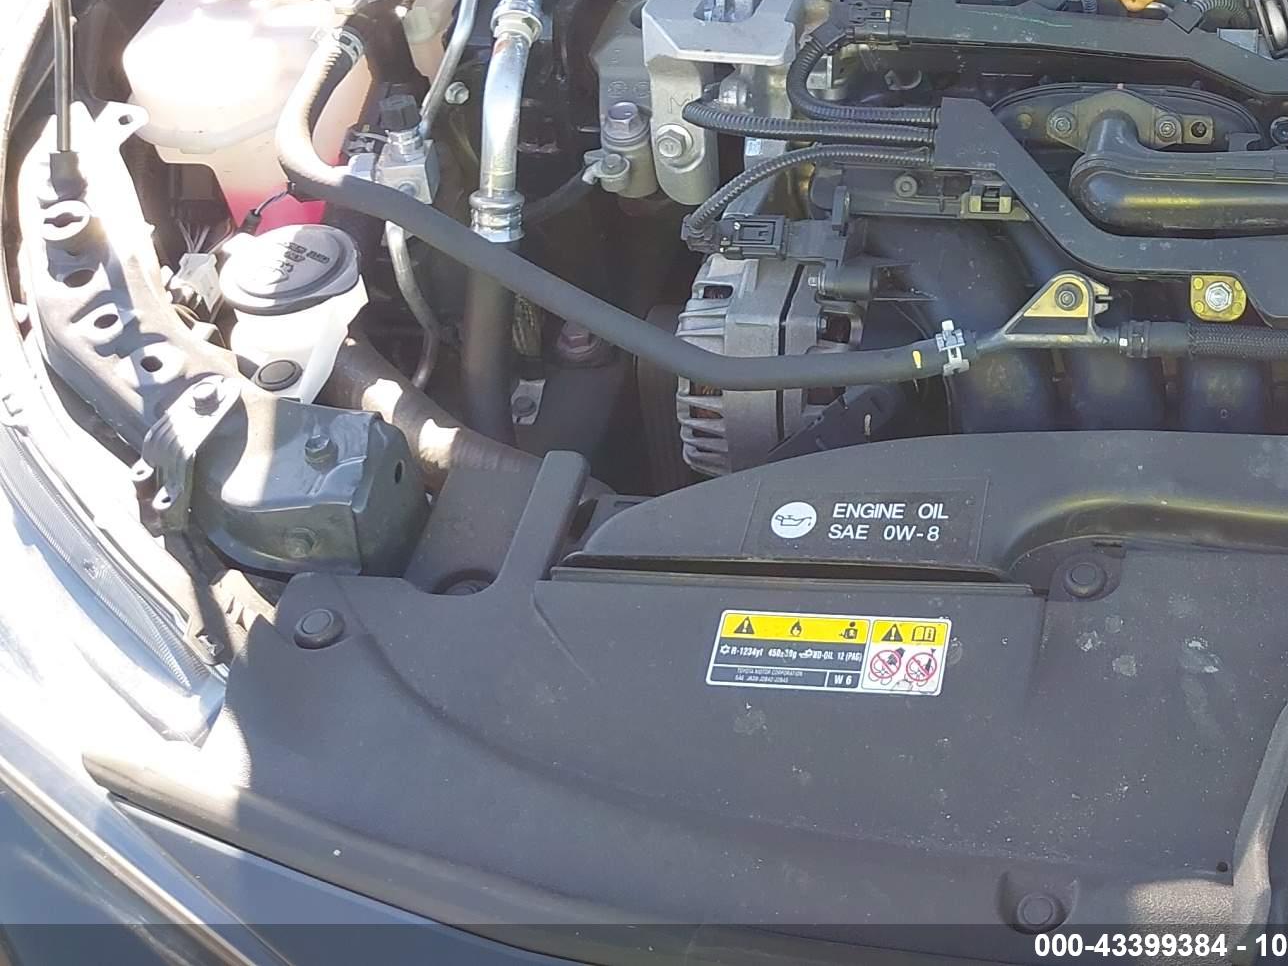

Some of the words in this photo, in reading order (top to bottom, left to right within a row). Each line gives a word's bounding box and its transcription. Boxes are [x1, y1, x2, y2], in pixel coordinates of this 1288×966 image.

[832, 503, 906, 519] ENGINE
[918, 503, 949, 519] OIL
[828, 524, 870, 540] SAE
[730, 645, 763, 658] R-1234yf
[837, 652, 844, 661] 12
